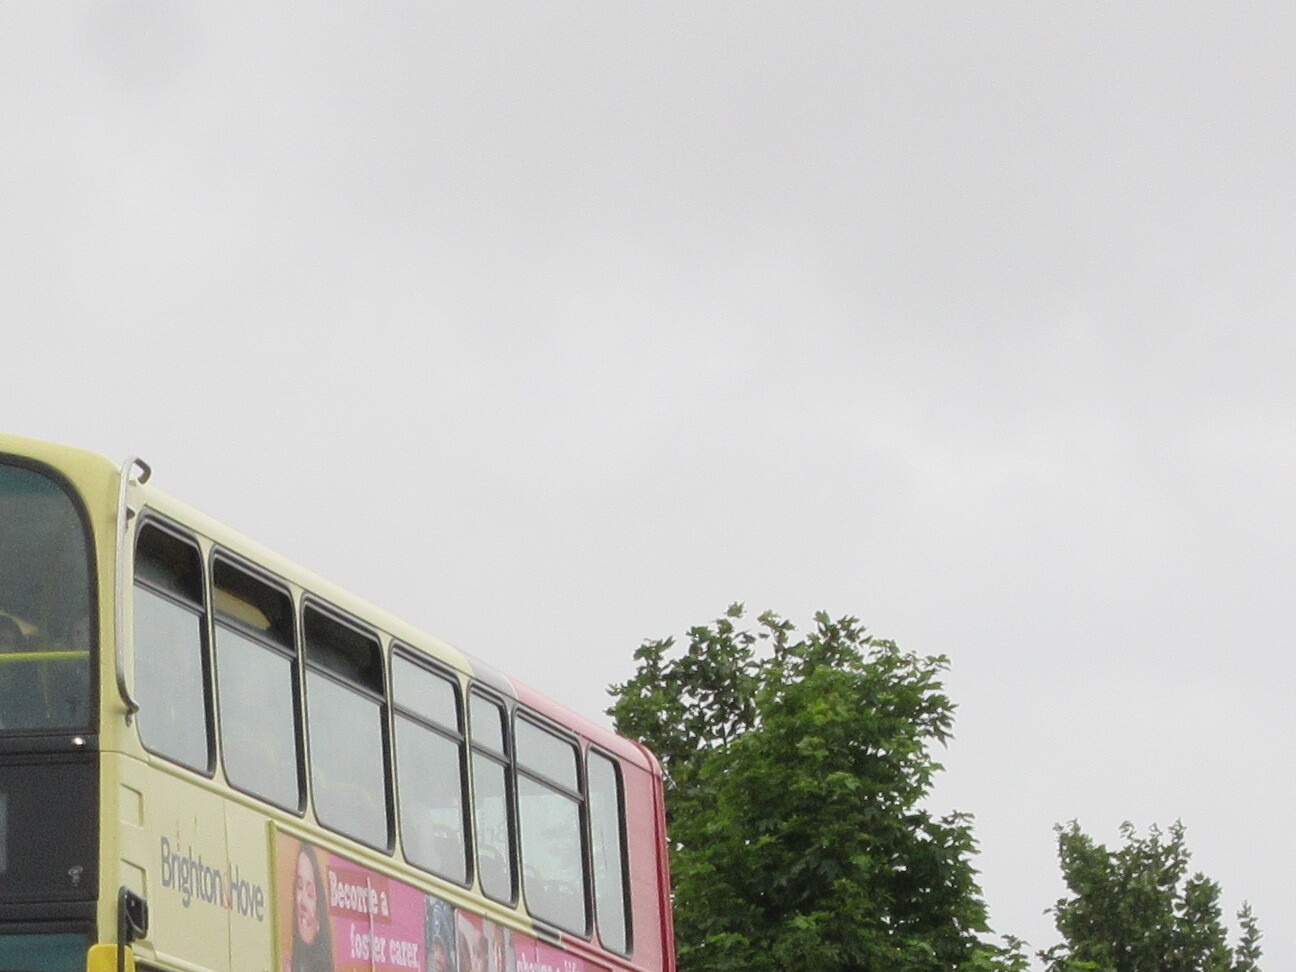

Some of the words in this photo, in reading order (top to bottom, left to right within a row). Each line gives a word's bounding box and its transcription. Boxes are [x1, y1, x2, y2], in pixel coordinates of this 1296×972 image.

[328, 870, 379, 915] Become
[379, 890, 390, 916] a
[350, 922, 387, 963] foser
